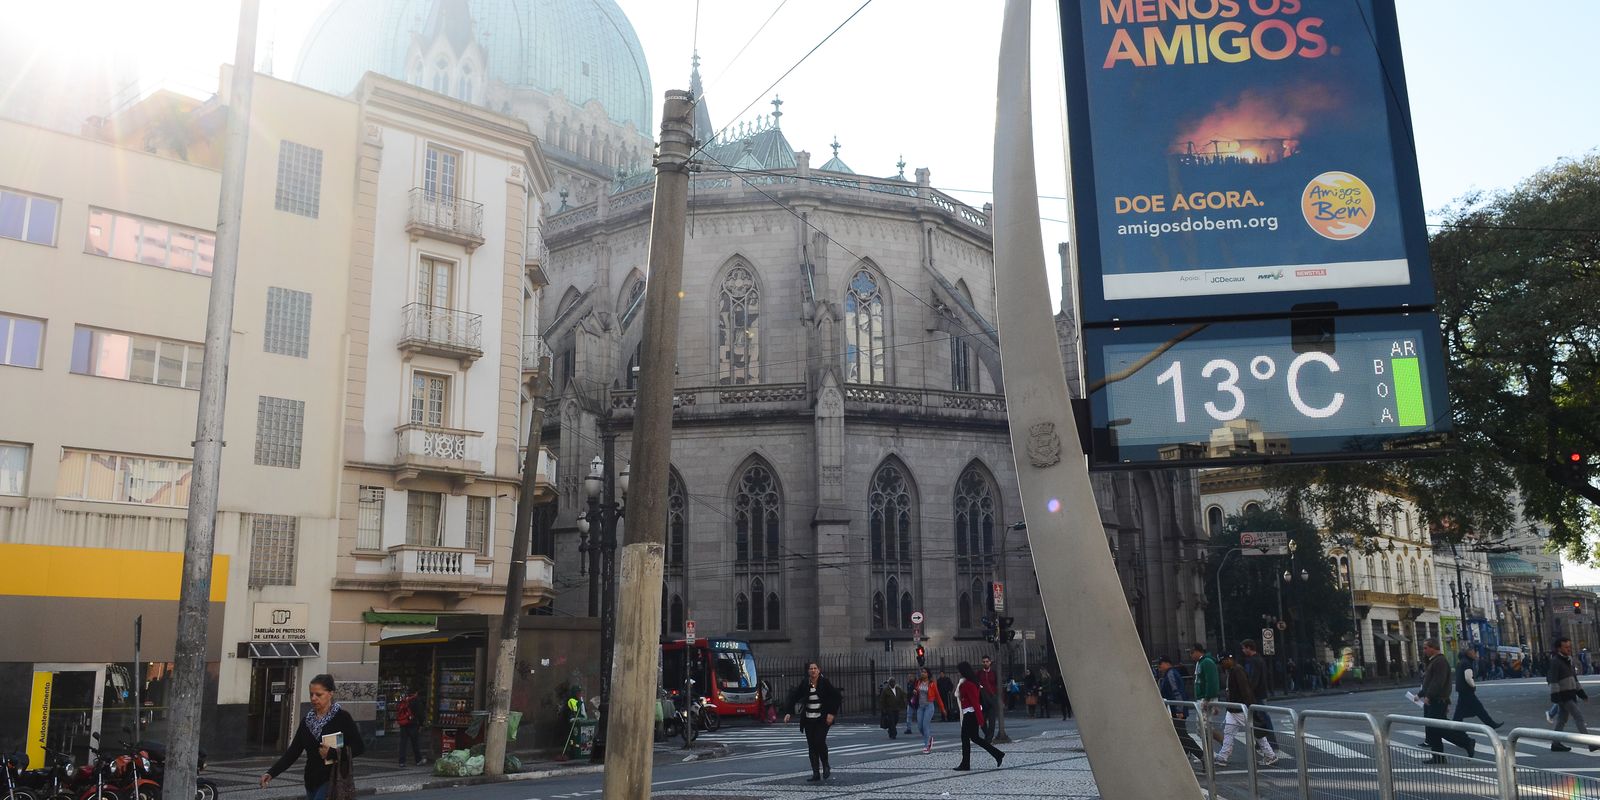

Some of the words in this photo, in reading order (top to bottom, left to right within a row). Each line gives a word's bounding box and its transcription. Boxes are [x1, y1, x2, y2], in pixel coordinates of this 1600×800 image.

[1100, 0, 1240, 24] MENOS
[1115, 194, 1166, 214] DOE
[1171, 190, 1265, 212] AGORA.
[1309, 185, 1361, 200] Amigos
[1311, 201, 1367, 221] Bem
[1117, 216, 1279, 238] amigosdobem.org
[1210, 276, 1245, 284] JCDecaux
[1390, 340, 1416, 357] AR
[1156, 351, 1345, 423] 13°C
[39, 682, 51, 744] Autoatendimento
